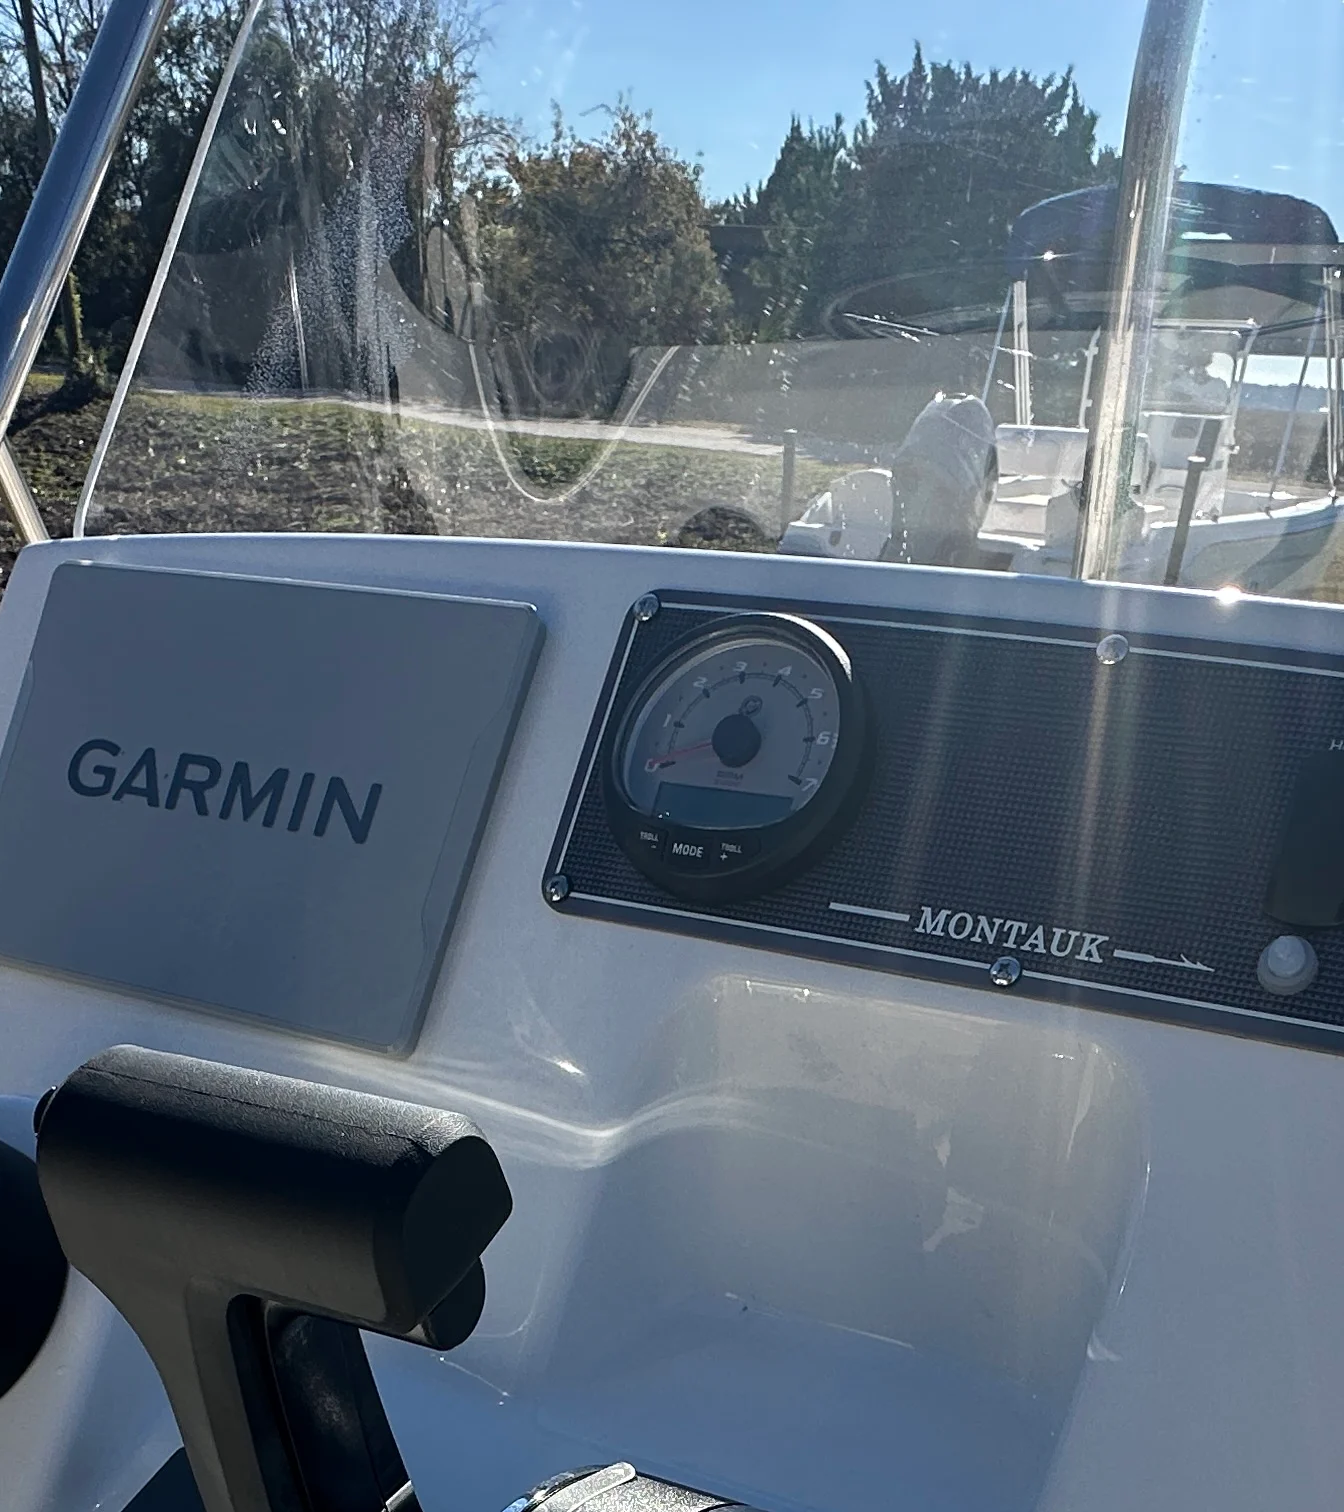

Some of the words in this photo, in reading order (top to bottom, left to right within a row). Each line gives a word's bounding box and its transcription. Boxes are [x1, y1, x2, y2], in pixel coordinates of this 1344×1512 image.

[734, 662, 747, 672] 3
[778, 666, 793, 676] 4
[694, 677, 708, 689] 2
[808, 688, 824, 699] 5
[663, 714, 672, 727] 1
[816, 732, 830, 745] 6
[801, 778, 818, 791] 7
[67, 739, 383, 845] GARMIN
[672, 842, 704, 858] MODE
[914, 906, 1110, 963] MONTAUK
